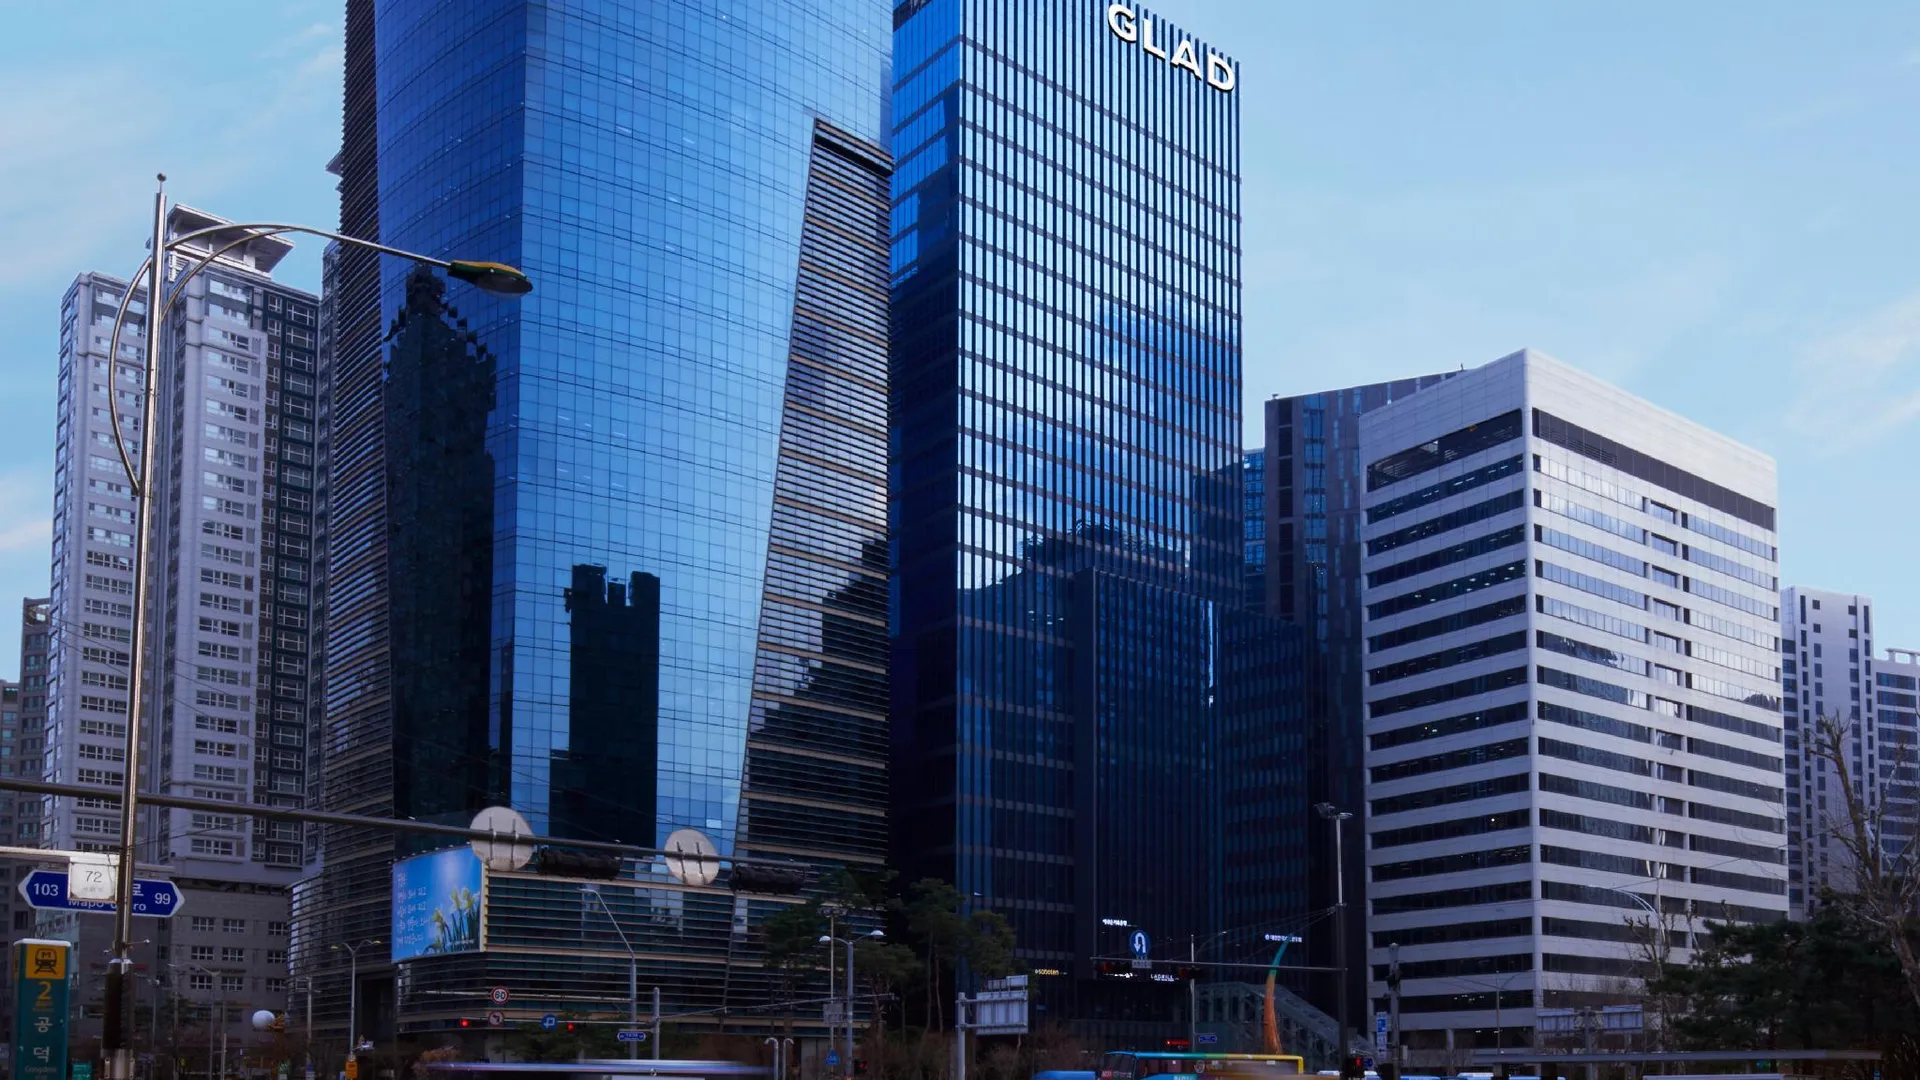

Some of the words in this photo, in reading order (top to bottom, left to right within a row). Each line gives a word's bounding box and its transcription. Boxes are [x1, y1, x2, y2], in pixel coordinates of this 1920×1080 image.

[1108, 3, 1236, 92] GLAD
[85, 870, 103, 883] 72
[33, 882, 59, 897] 103
[154, 892, 171, 905] 99
[38, 981, 52, 1000] 2
[494, 990, 506, 1000] 60
[33, 1016, 53, 1063] 공덕
